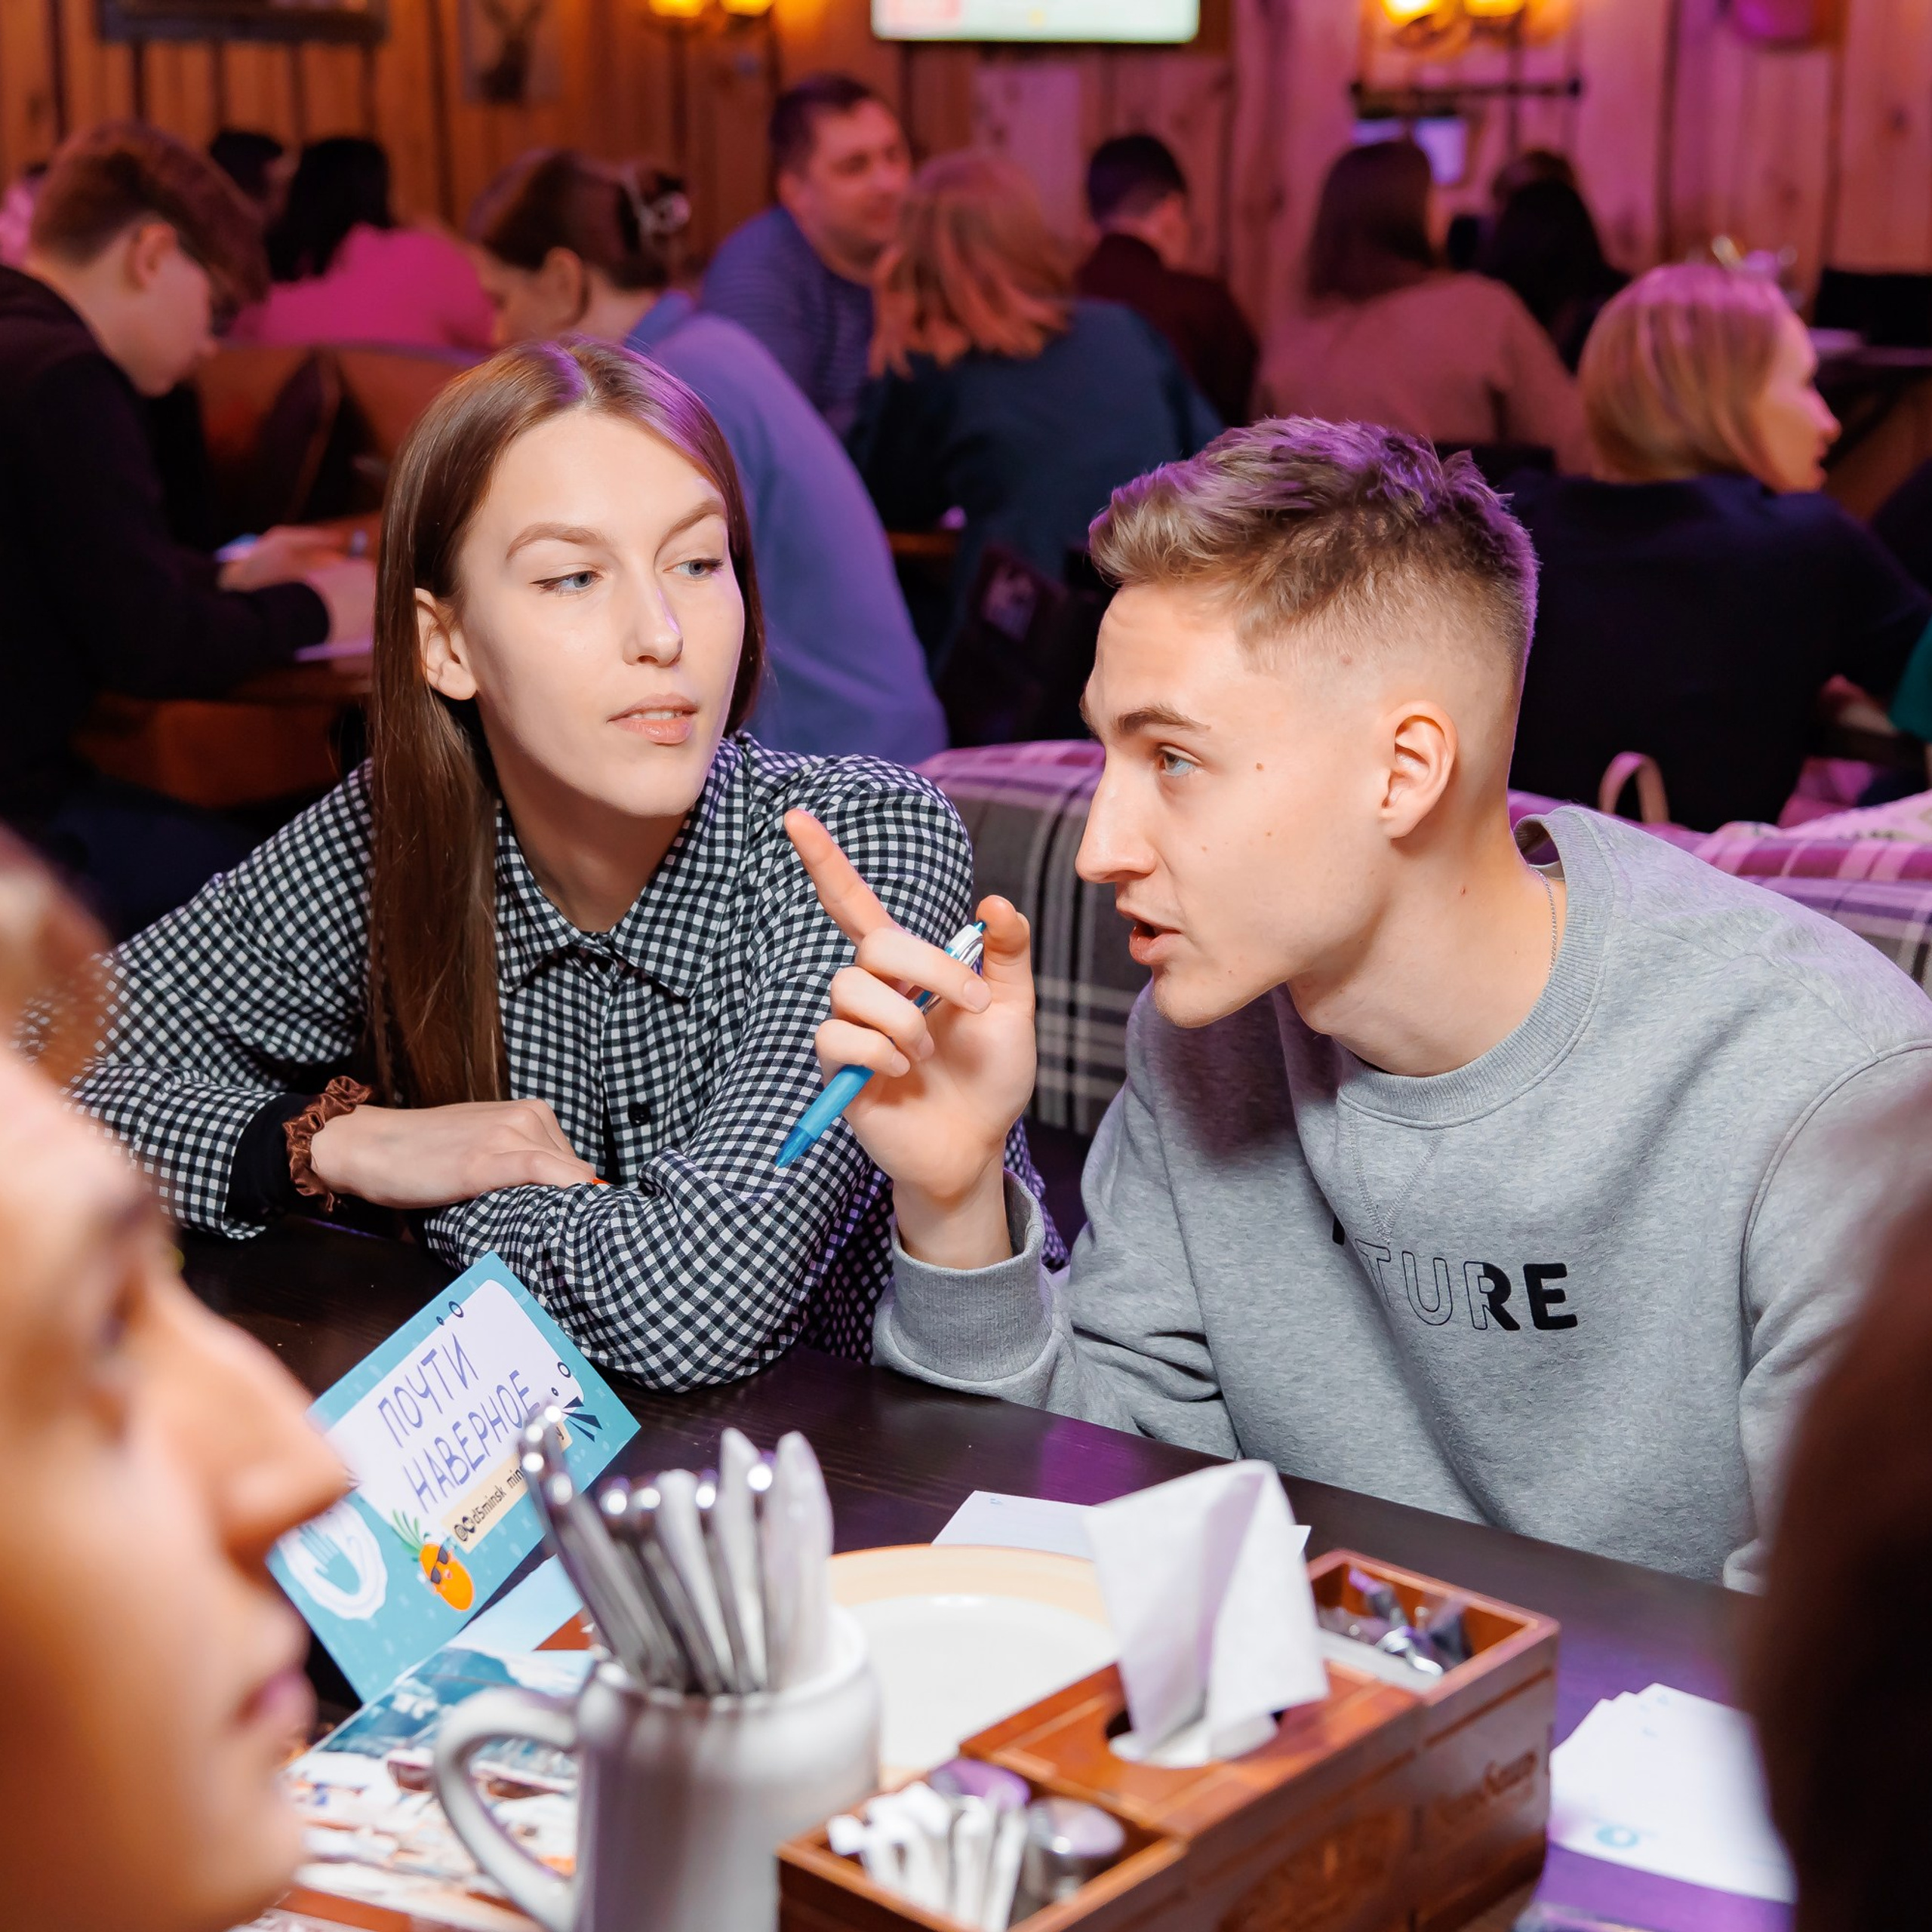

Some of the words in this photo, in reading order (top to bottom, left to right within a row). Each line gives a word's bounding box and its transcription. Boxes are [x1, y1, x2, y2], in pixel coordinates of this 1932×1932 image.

[1332, 1213, 1578, 1331] TURE
[377, 1331, 479, 1449] ПОЧТИ
[402, 1369, 540, 1514] НАВЕРНОЕ
